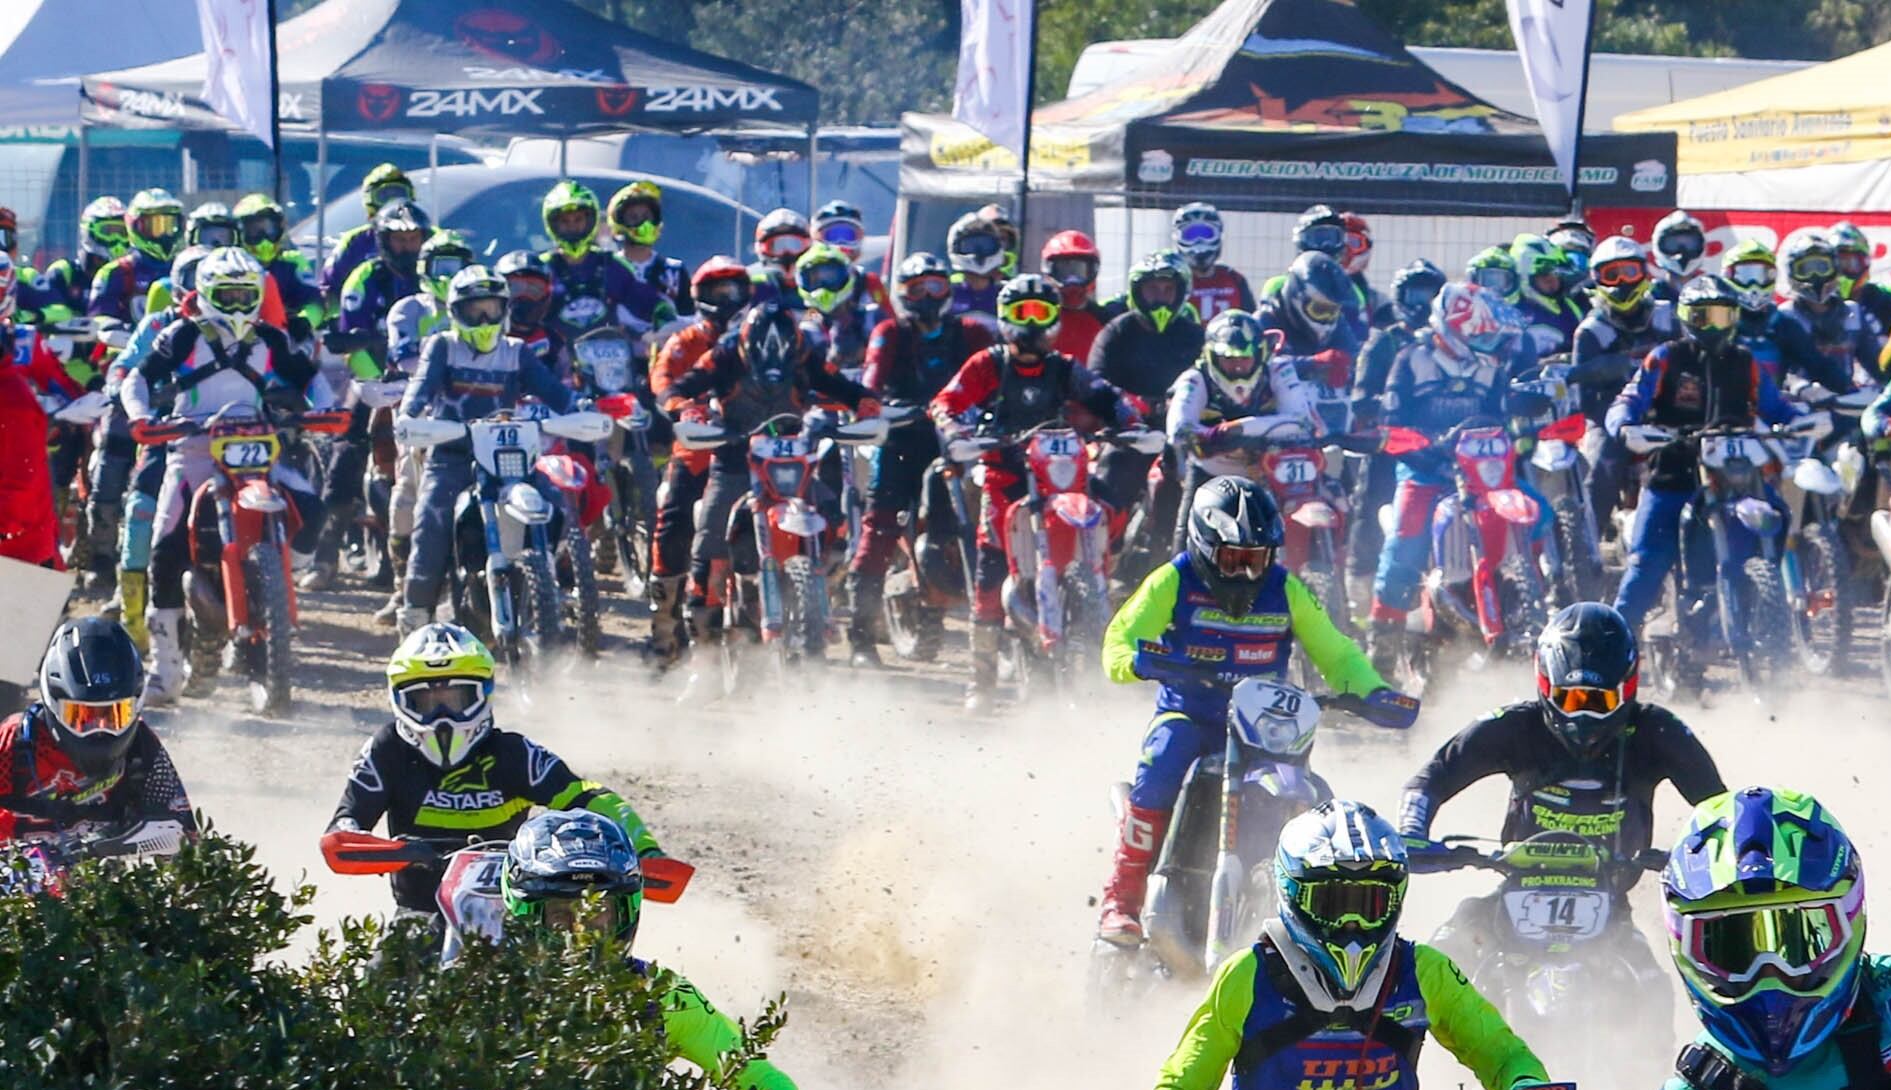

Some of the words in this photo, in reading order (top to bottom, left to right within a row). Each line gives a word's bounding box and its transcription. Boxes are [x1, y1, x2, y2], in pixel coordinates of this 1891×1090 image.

[406, 89, 544, 117] 24MX
[644, 86, 782, 112] 24MX
[496, 429, 518, 447] 49
[240, 445, 261, 462] 22
[1285, 463, 1304, 481] 31
[1271, 689, 1302, 714] 20
[422, 790, 505, 811] ASTARS
[1547, 897, 1577, 925] 14
